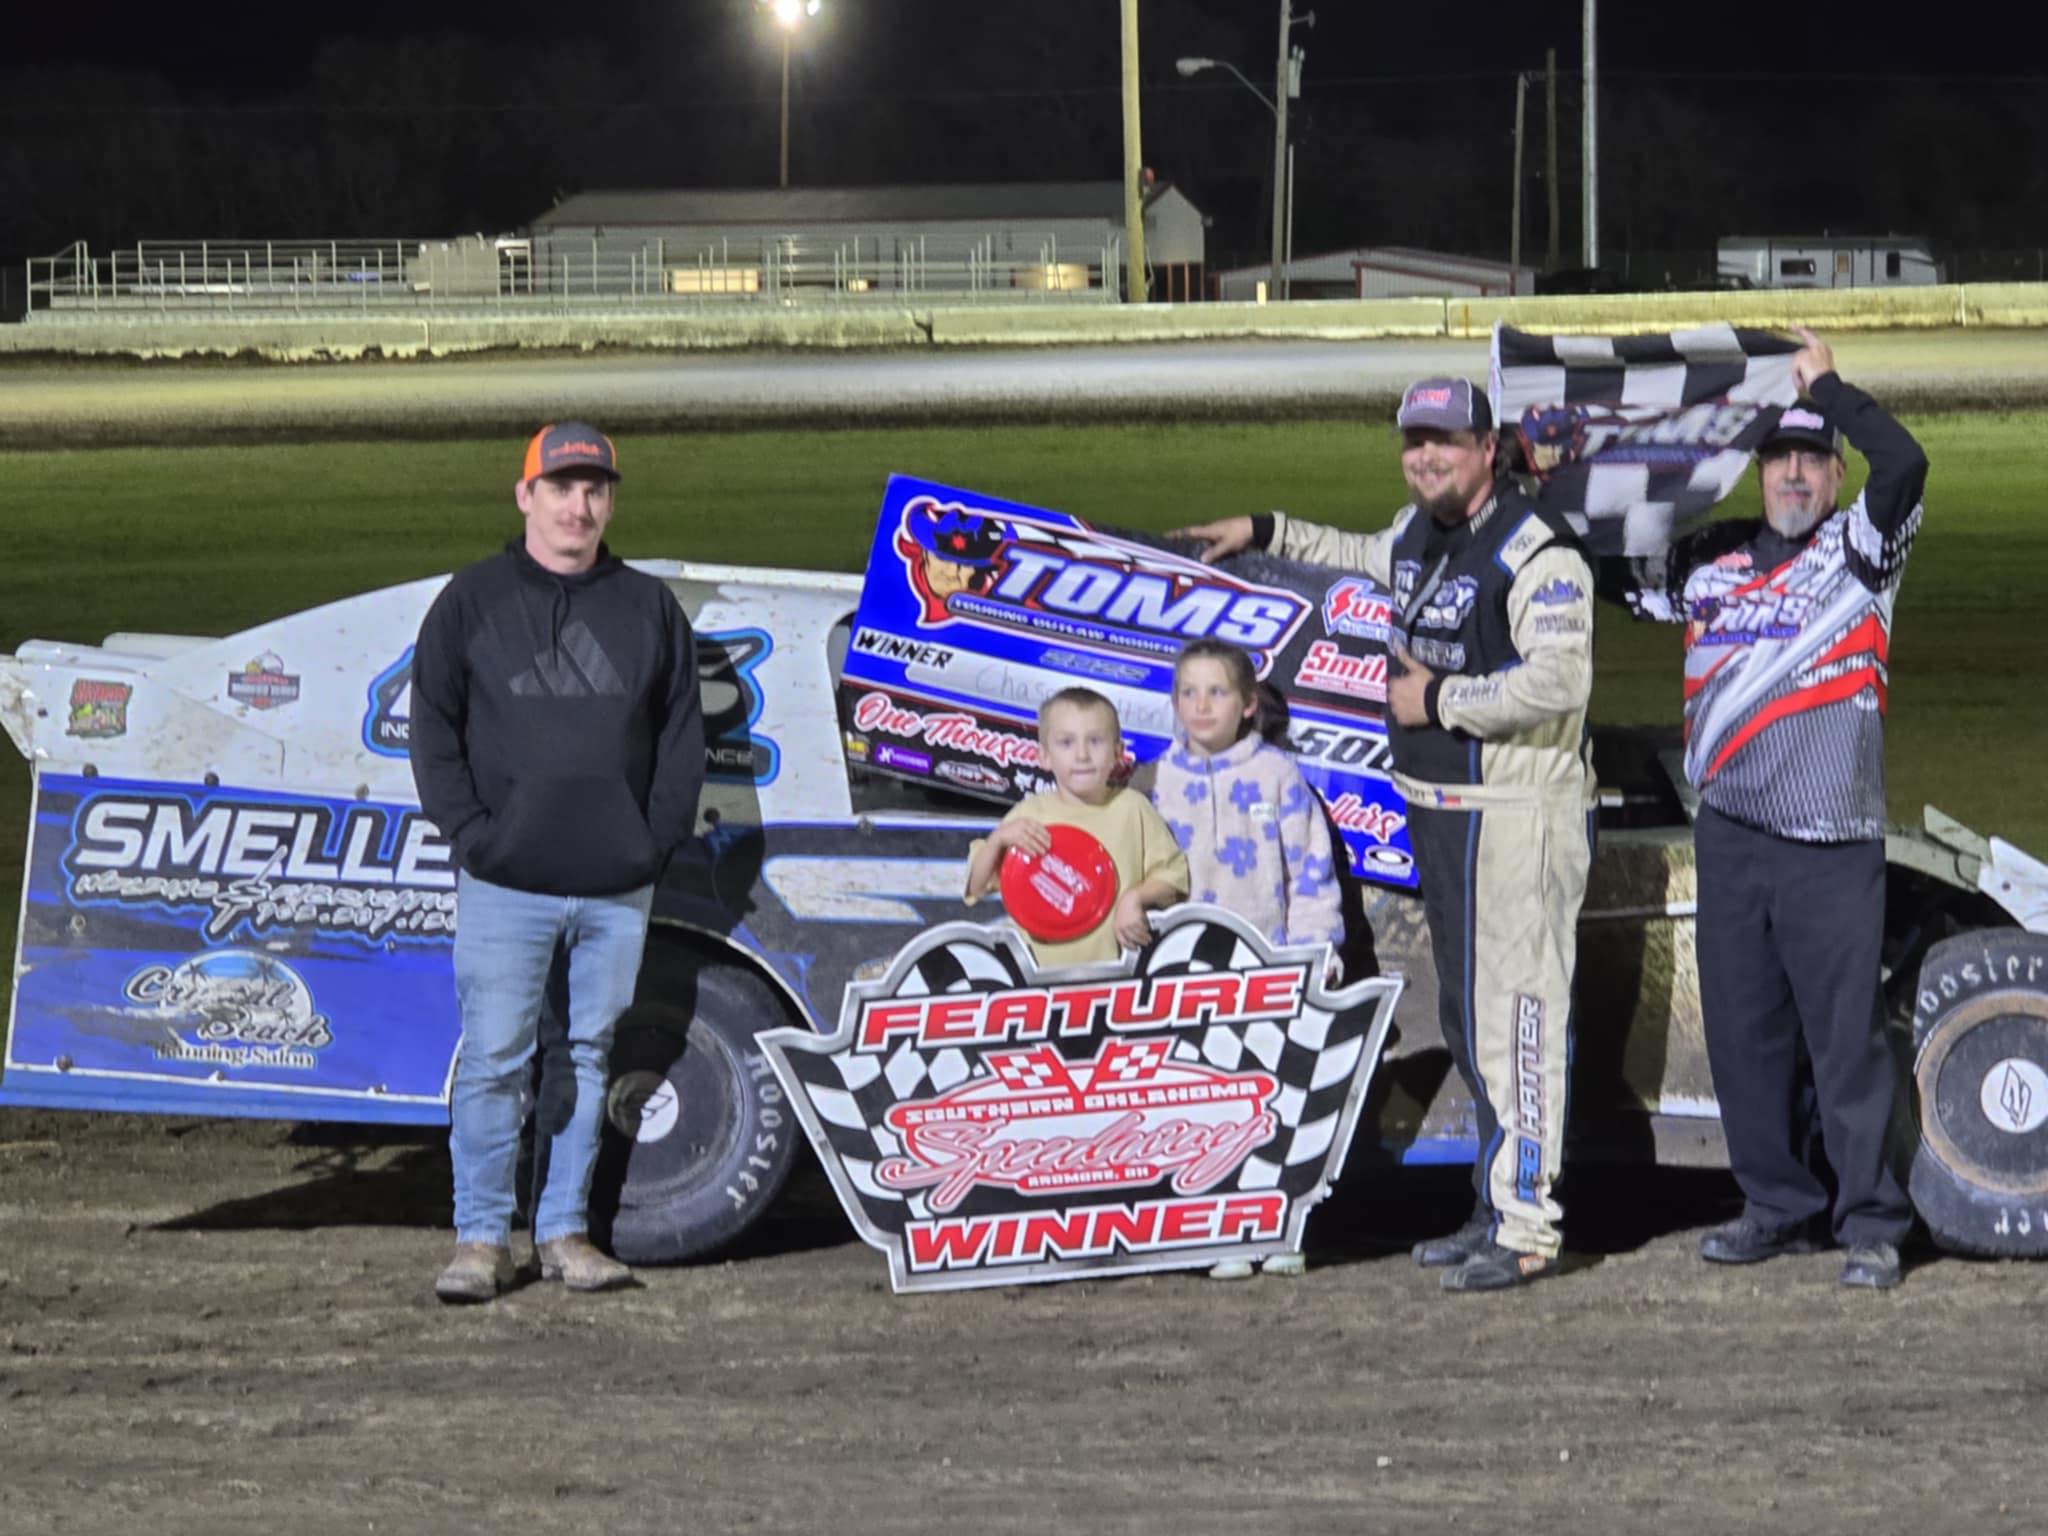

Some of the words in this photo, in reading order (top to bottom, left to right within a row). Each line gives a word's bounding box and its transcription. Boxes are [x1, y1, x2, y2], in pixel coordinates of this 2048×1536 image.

[998, 546, 1294, 646] TOMS
[857, 629, 954, 669] WINNER
[1301, 641, 1388, 685] Smil
[854, 692, 922, 738] One
[1325, 792, 1407, 845] llars
[860, 967, 1305, 1053] FEATURE
[904, 1096, 1075, 1125] SOUTHERN
[1083, 1080, 1260, 1109] OKLAHOMA
[880, 1109, 1274, 1211] Speedway
[906, 1192, 1287, 1274] WINNER
